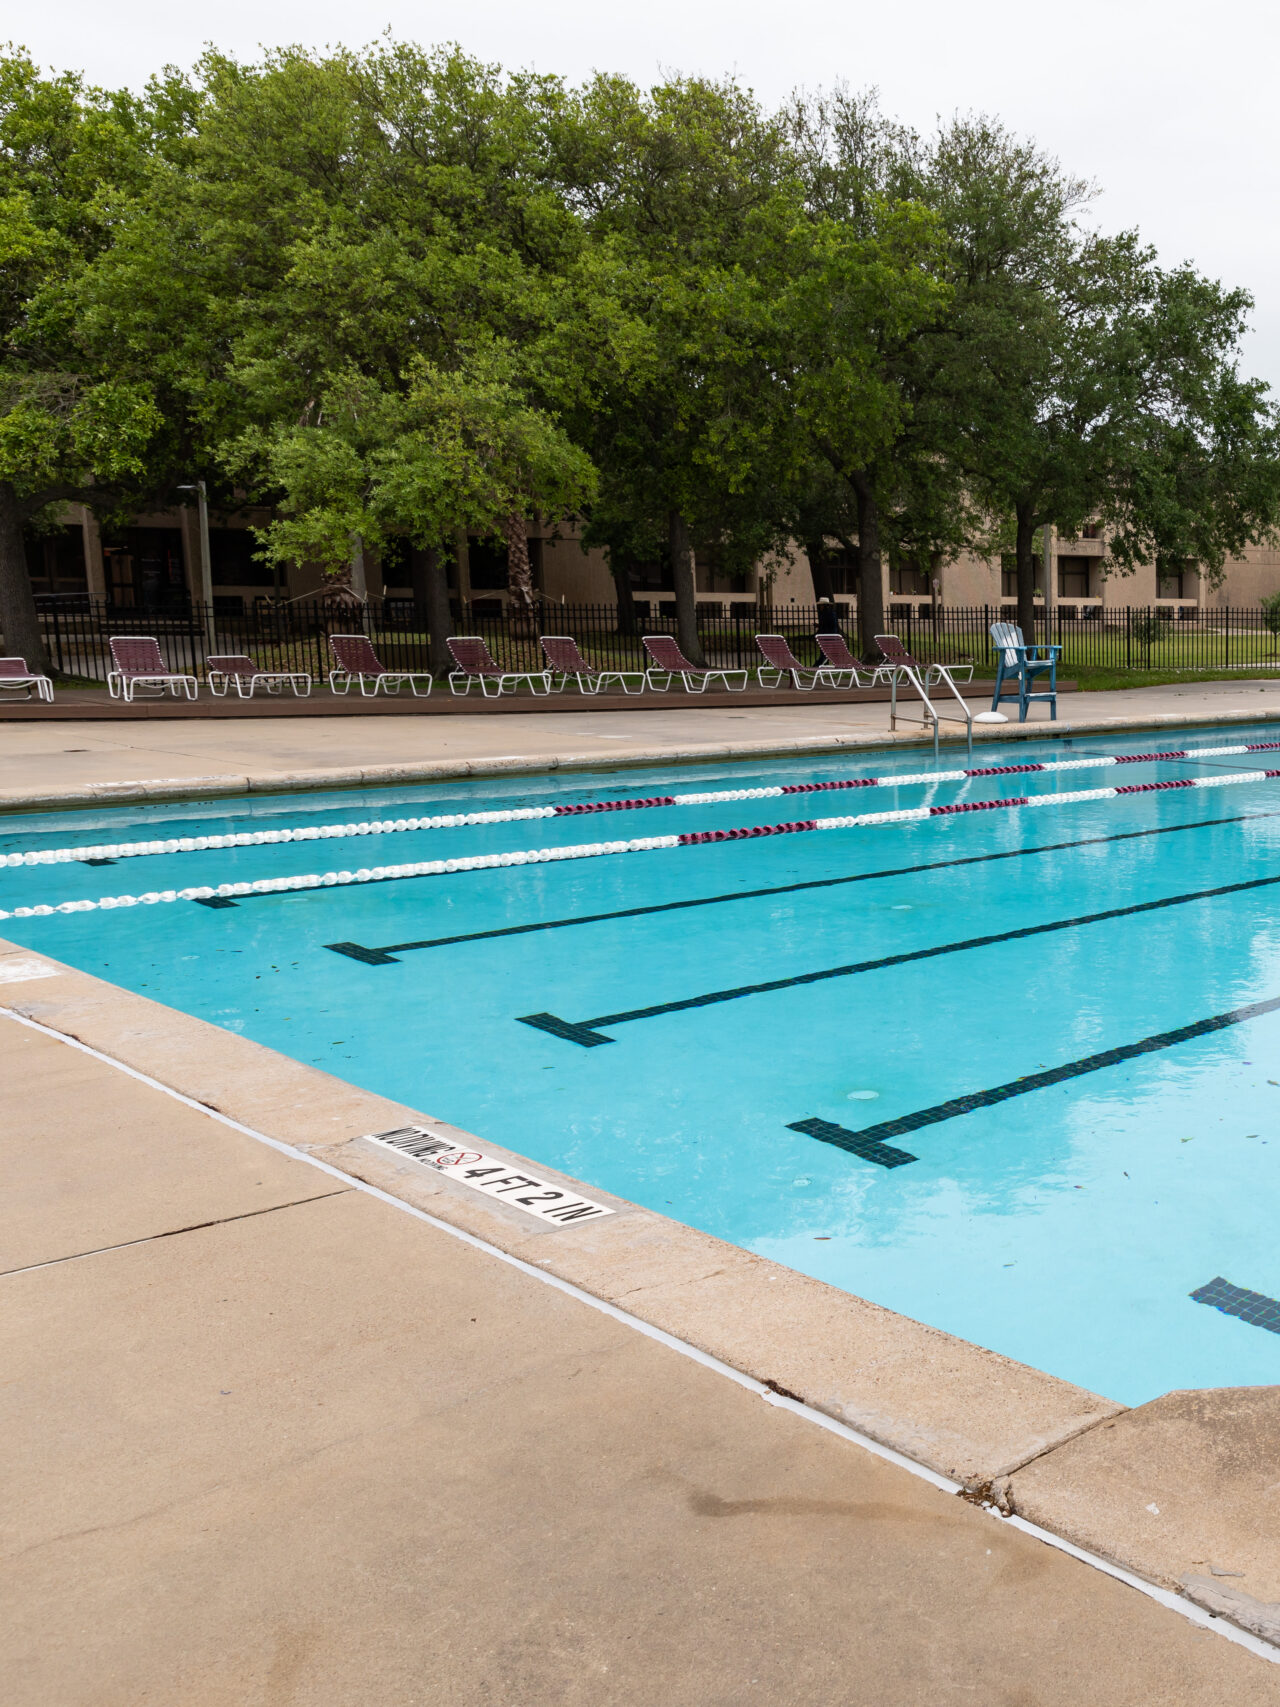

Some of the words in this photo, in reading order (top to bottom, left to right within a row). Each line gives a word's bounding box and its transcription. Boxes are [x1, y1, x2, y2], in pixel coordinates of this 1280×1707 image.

[371, 1127, 421, 1141] NO
[385, 1133, 457, 1158] DIVING
[463, 1166, 506, 1179] 4
[480, 1174, 542, 1194] FT
[515, 1191, 565, 1206] 2
[541, 1201, 603, 1221] IN
